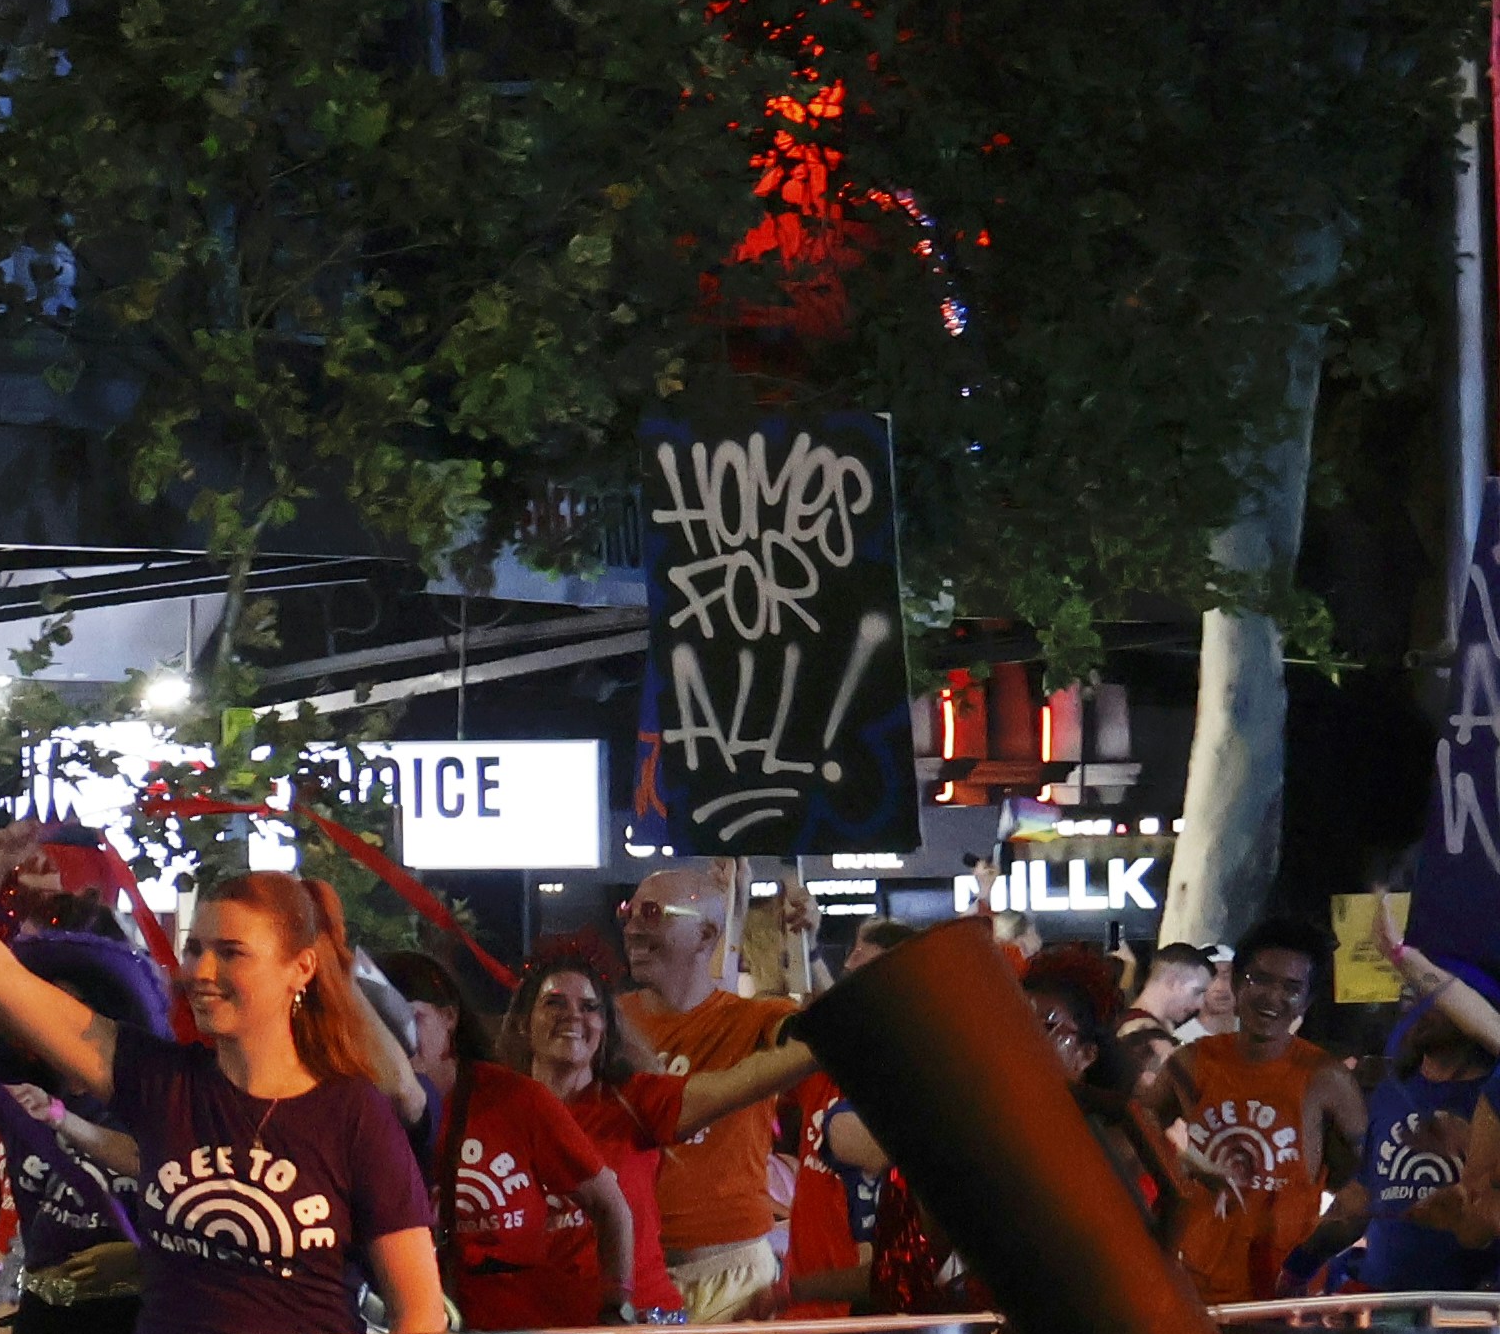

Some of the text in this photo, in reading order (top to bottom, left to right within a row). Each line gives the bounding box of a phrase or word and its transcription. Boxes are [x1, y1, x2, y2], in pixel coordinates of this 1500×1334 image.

[668, 529, 820, 641] FOR
[661, 610, 894, 784] ALL!
[144, 1144, 236, 1212] FREE
[248, 1147, 298, 1193] TO
[292, 1193, 337, 1251] BE
[489, 1151, 530, 1196] BE
